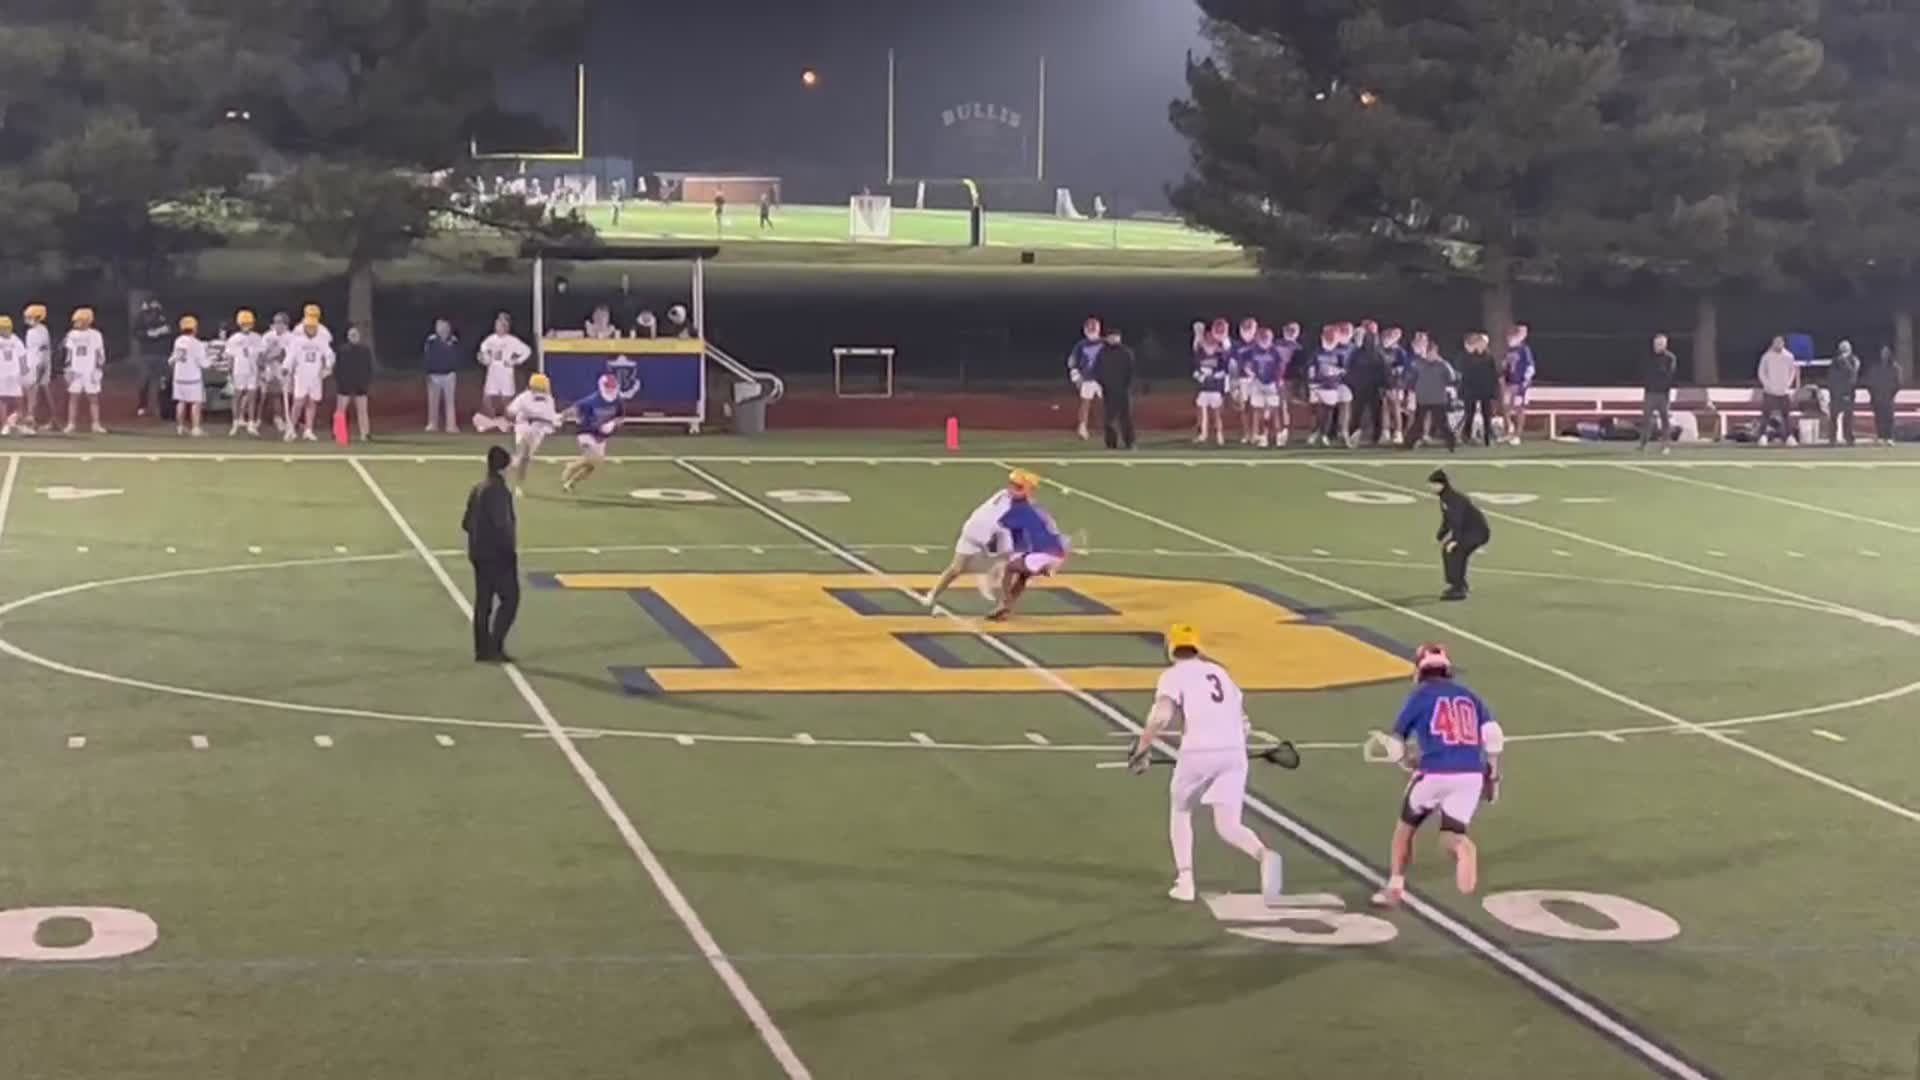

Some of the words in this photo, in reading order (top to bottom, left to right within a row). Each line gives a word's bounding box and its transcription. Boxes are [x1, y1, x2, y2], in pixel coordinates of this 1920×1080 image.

[942, 103, 1021, 128] BULLIS
[1206, 673, 1224, 703] 3
[1430, 696, 1479, 746] 40
[1203, 890, 1680, 945] 50
